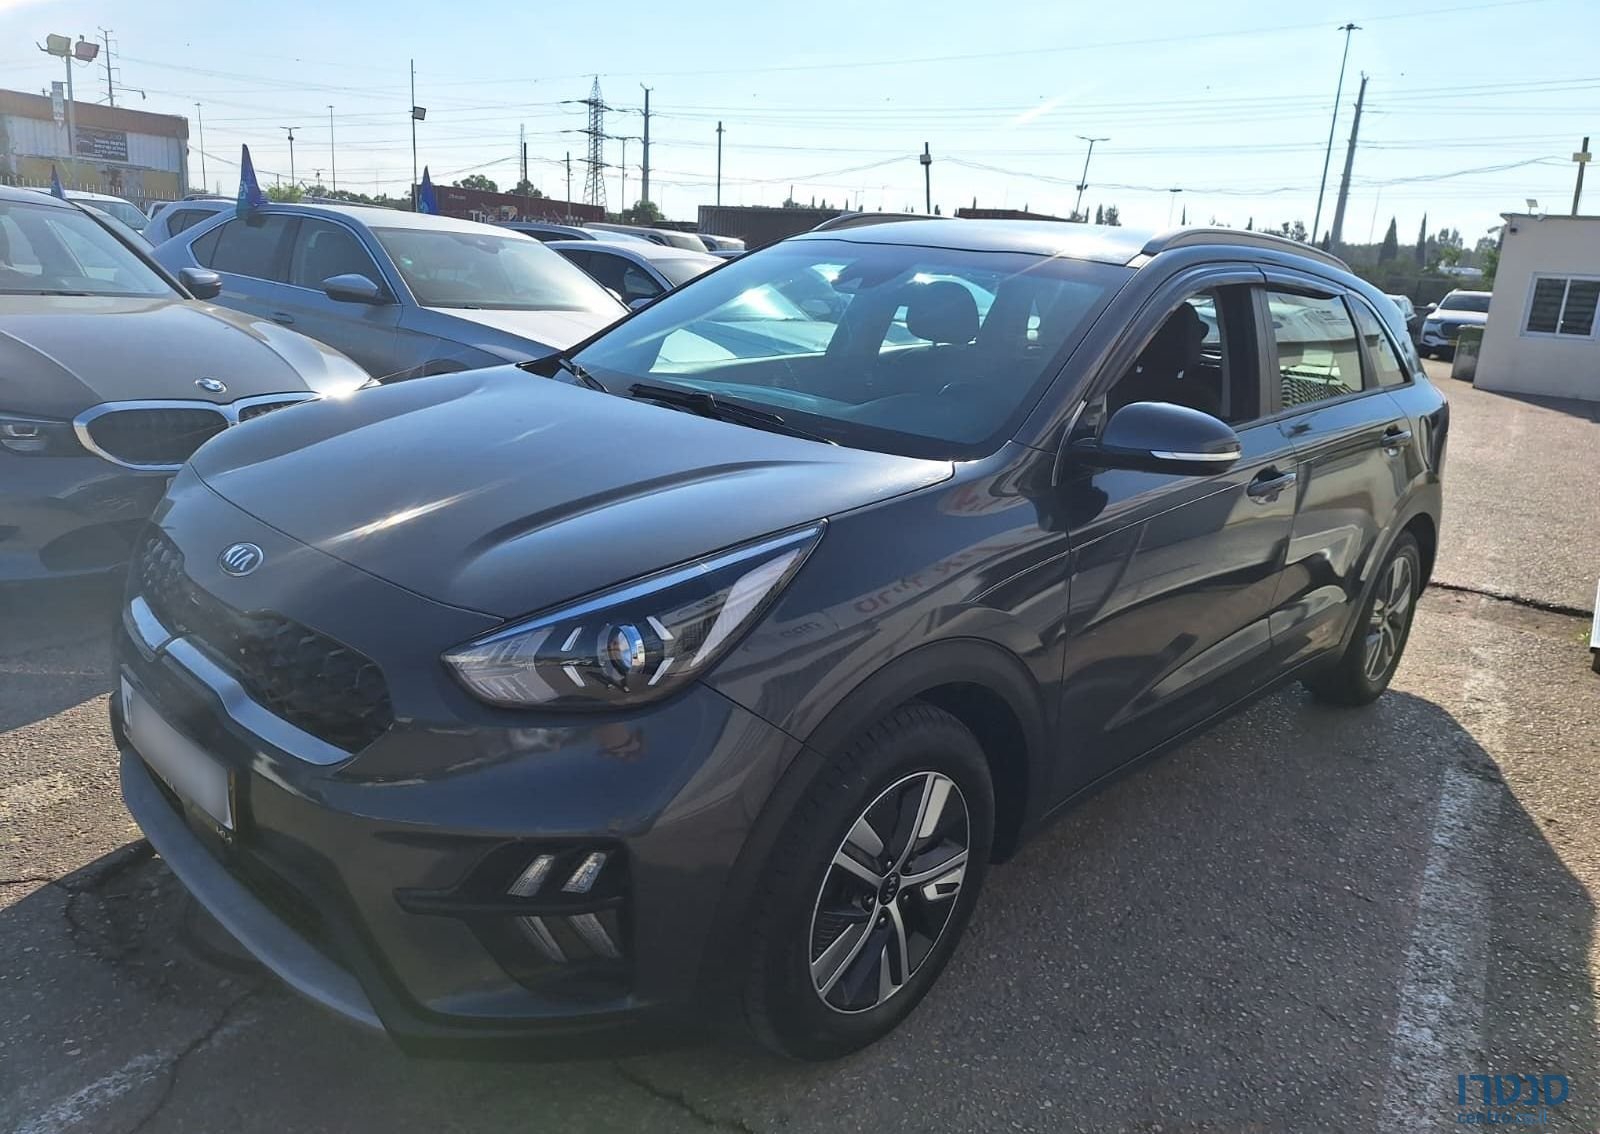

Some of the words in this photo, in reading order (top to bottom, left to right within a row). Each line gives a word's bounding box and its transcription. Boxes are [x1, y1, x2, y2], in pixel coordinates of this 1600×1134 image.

[469, 209, 496, 224] The
[223, 545, 254, 571] KIA
[885, 876, 897, 903] KIA
